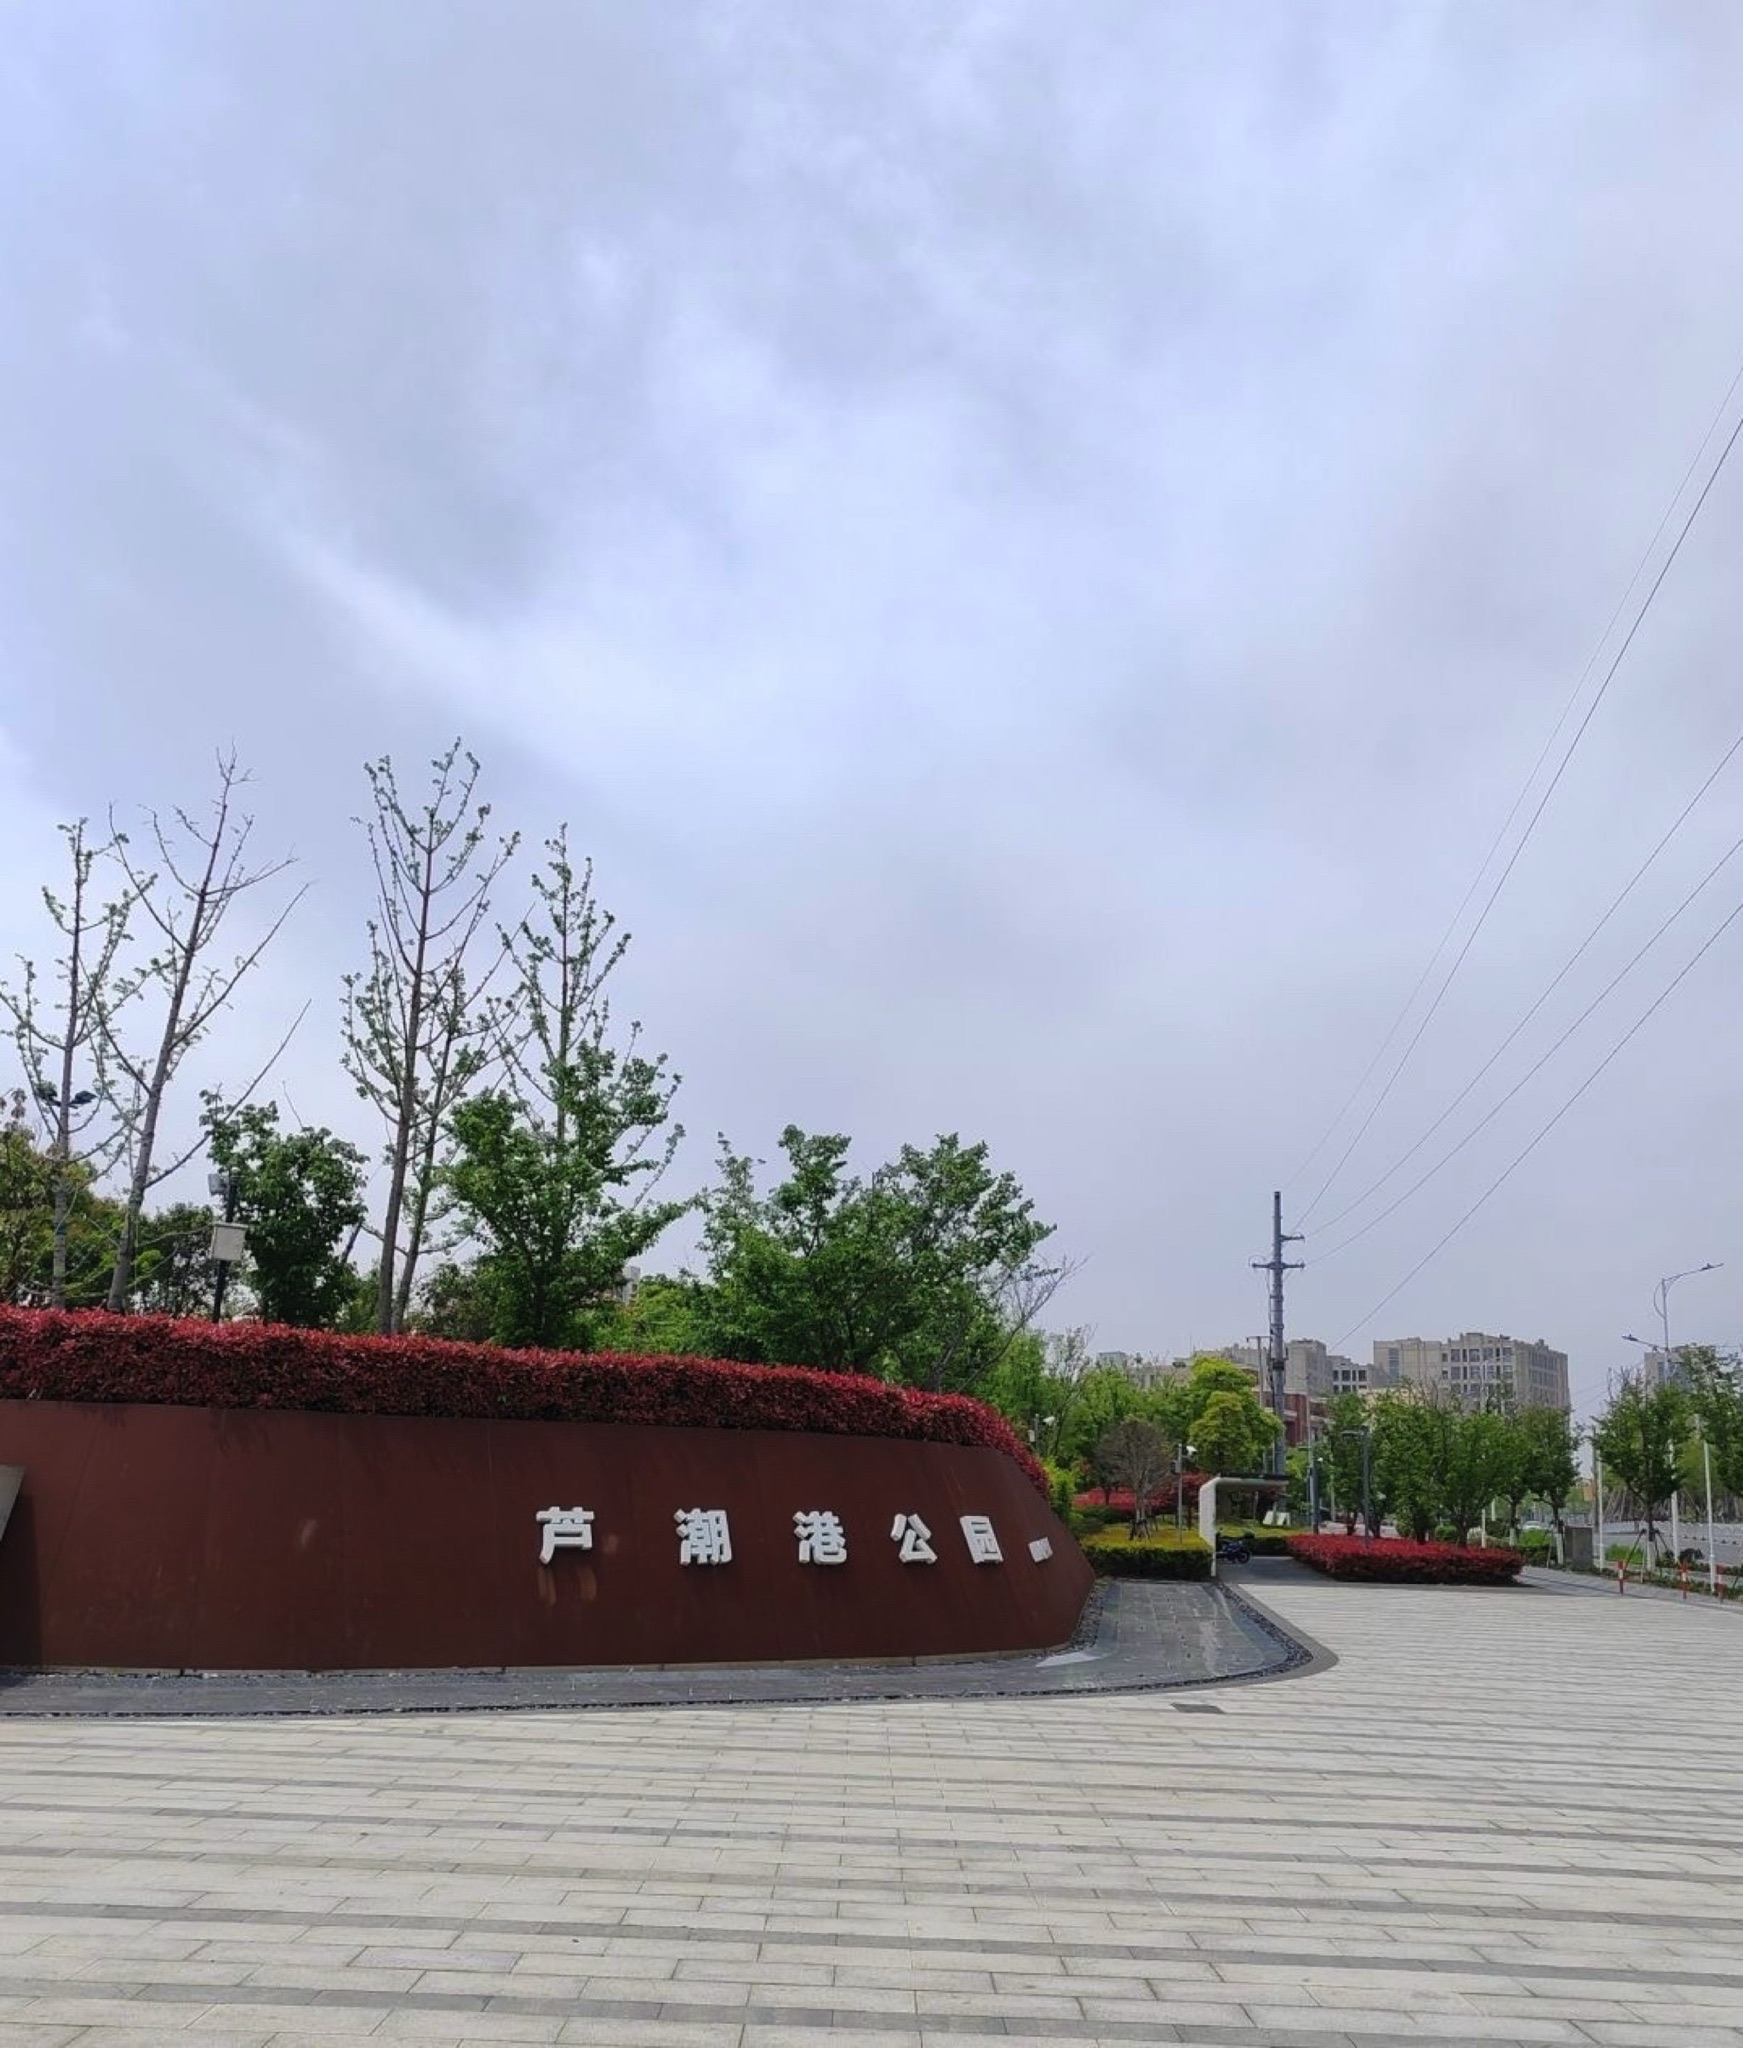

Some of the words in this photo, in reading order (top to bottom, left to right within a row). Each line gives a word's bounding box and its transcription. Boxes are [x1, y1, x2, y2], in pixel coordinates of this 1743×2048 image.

[536, 1505, 1004, 1565] 芦潮港公园
